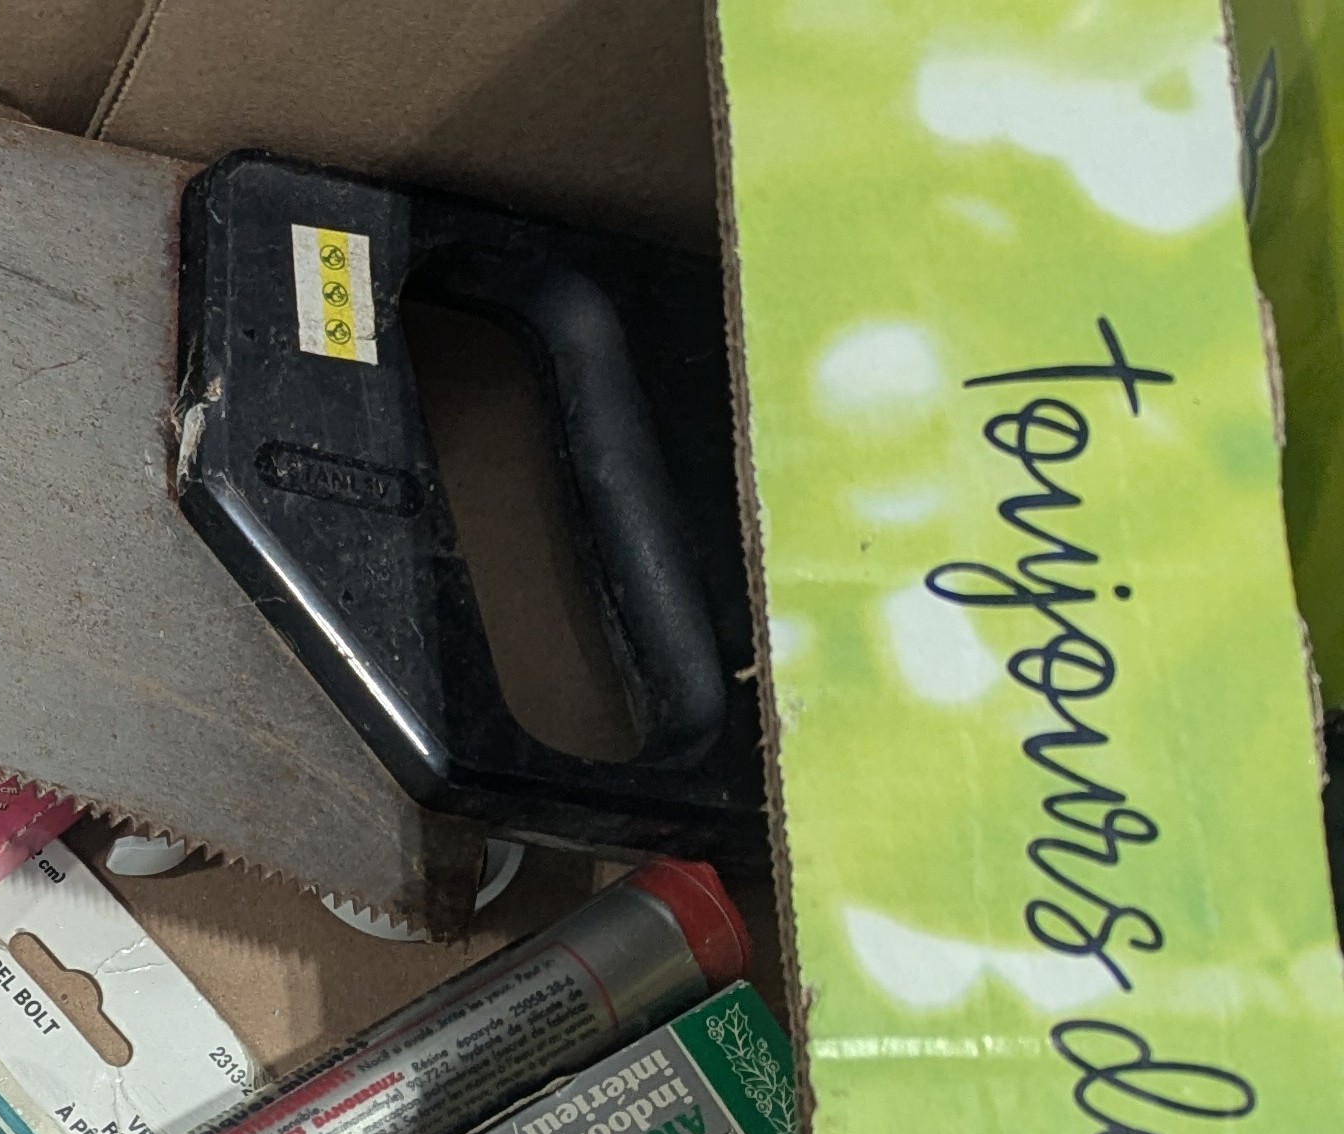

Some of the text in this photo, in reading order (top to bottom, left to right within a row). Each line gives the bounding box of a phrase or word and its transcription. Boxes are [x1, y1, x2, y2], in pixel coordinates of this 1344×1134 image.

[923, 314, 1175, 993] toujours
[0, 785, 18, 795] cm
[12, 987, 61, 1035] BOLT
[53, 1098, 79, 1124] À
